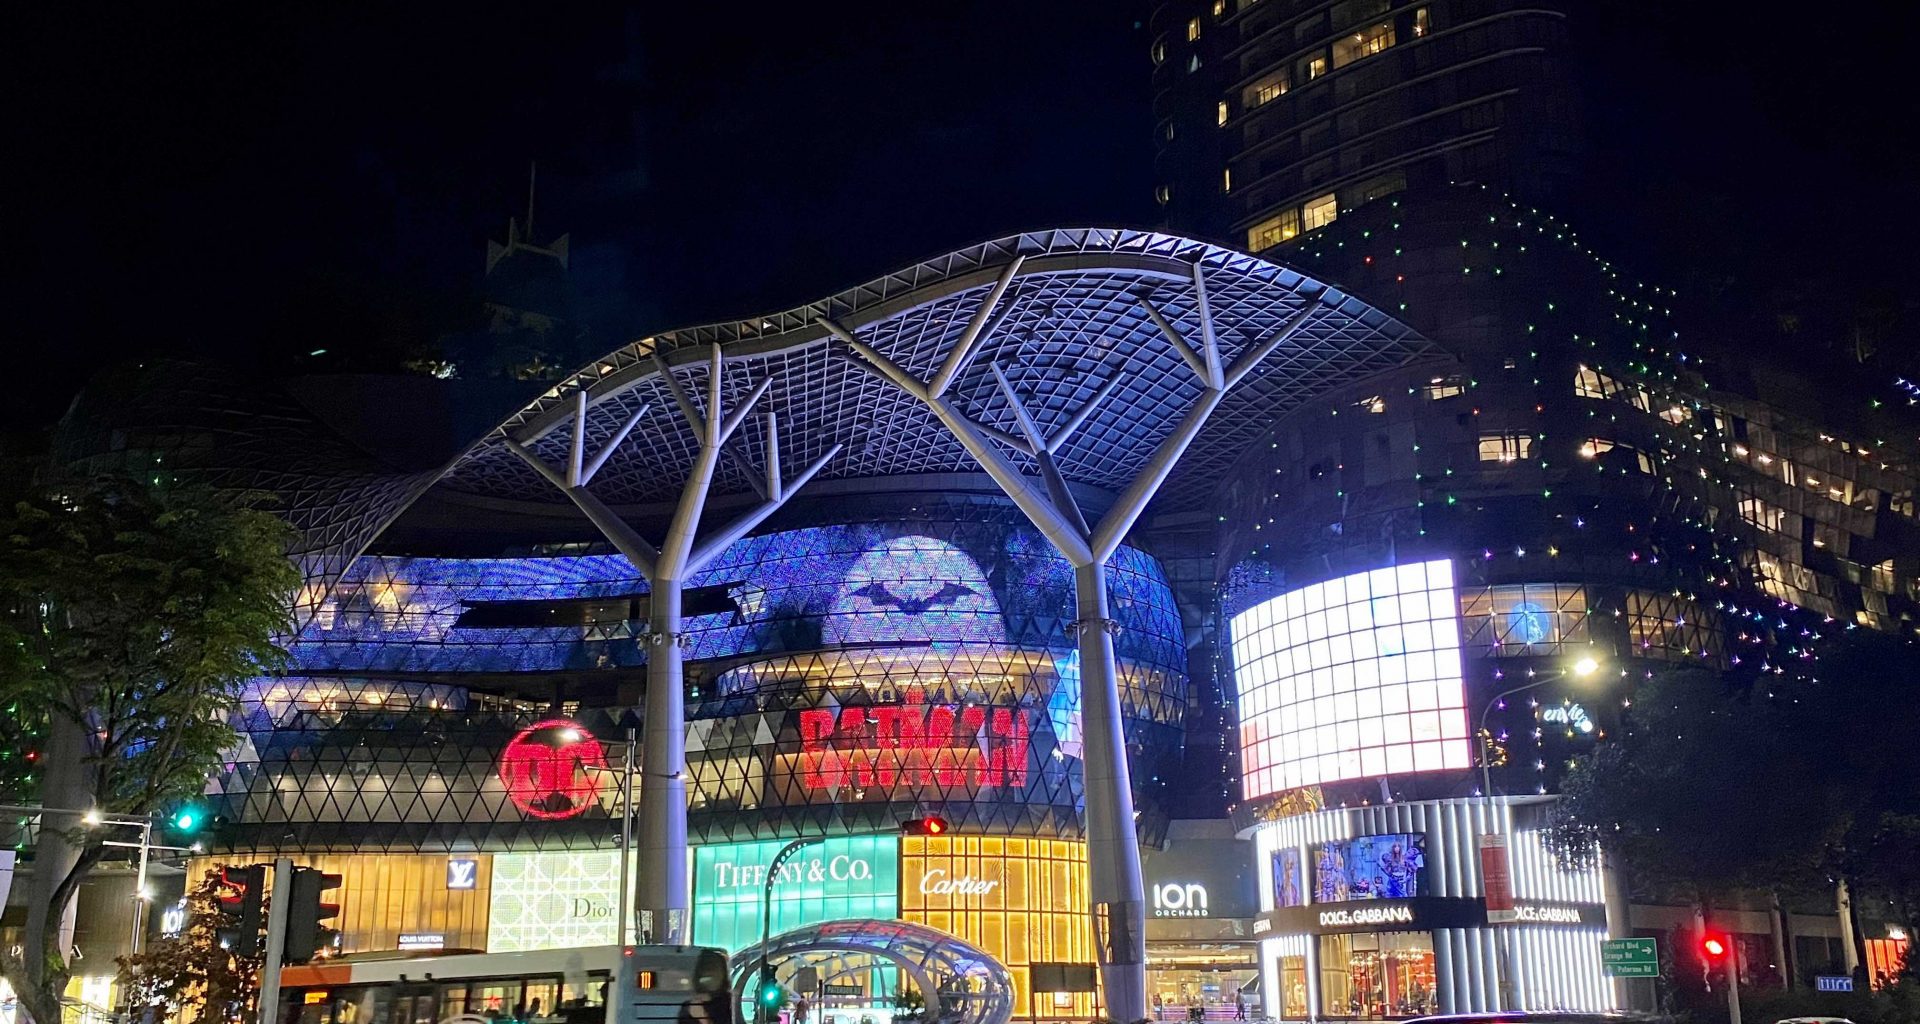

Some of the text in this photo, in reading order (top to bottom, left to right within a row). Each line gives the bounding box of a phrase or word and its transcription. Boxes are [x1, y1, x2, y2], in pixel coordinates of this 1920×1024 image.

[714, 862, 806, 888] TIFFNY
[919, 869, 999, 895] Cartier
[574, 898, 616, 918] Dior
[1155, 909, 1209, 917] ORCHARD
[399, 935, 444, 943] LOUIS VUITTON
[1625, 951, 1633, 959] Rd
[1643, 965, 1652, 973] Rd
[640, 971, 652, 991] 111
